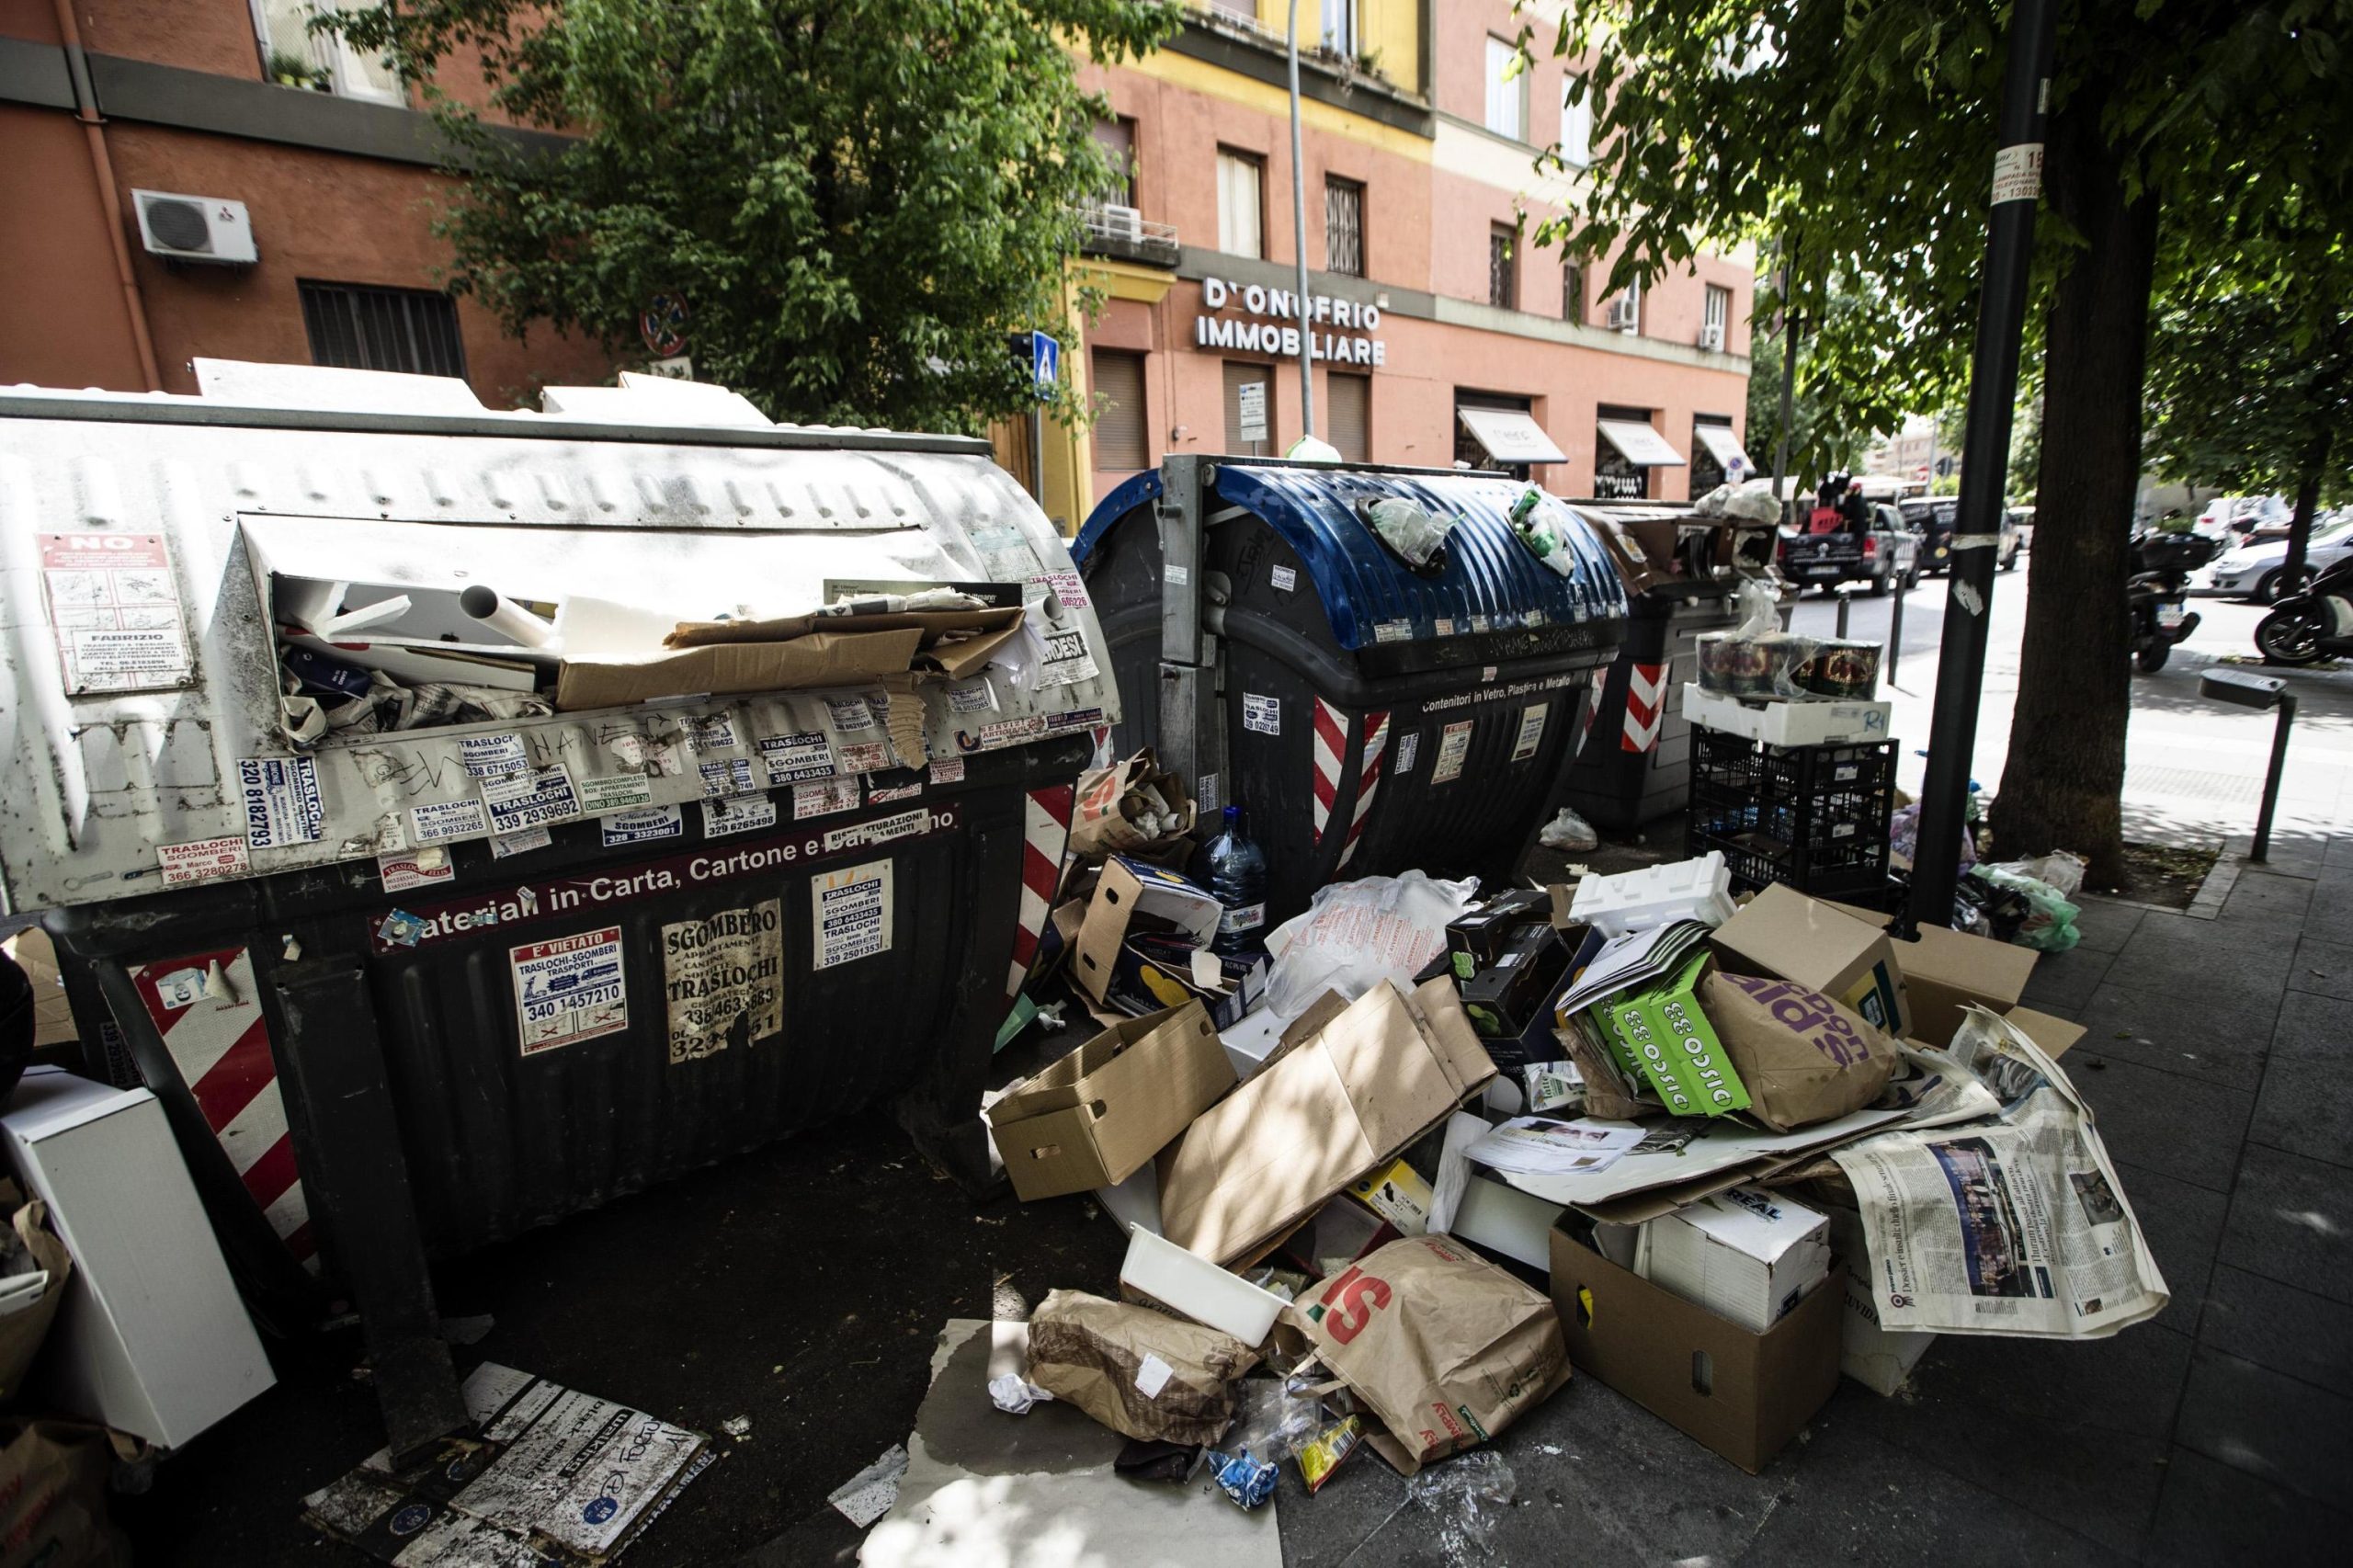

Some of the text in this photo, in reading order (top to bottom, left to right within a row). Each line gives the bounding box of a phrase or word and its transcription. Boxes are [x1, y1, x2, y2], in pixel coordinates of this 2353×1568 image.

[1198, 315, 1386, 365] IMMOBLIARE
[71, 536, 134, 550] NO
[1474, 691, 1482, 703] in
[1483, 688, 1506, 701] Vetro,
[463, 748, 508, 757] SGOMBERI
[763, 736, 823, 750] TRASLOCHI
[467, 760, 529, 777] 338 6715053
[767, 753, 829, 768] SGOMBERI
[270, 761, 281, 785] SIMONE
[483, 774, 527, 788] SGOMBRO
[614, 775, 645, 785] COMPLETO
[775, 767, 832, 782] 380 6433435
[600, 781, 645, 792] APPARTAMENTI
[600, 790, 633, 799] TRASLOCHI
[241, 761, 271, 846] 320 8182793
[290, 759, 310, 840] SGOMBRO CANTINE
[299, 759, 322, 838] TRASLOCHI
[415, 799, 480, 815] TRASLOCHI
[496, 789, 569, 812] TRASLOCHI
[586, 801, 606, 811] DINO
[420, 813, 481, 828] SGOMBERI
[496, 801, 579, 831] 339 2939692
[614, 816, 669, 830] SGOMBERI
[709, 816, 774, 835] 329 6265498
[420, 828, 440, 839] 366
[441, 821, 484, 835] 9932265
[609, 826, 676, 844] 328 3323001
[162, 838, 244, 855] TRASLOCHI
[167, 846, 242, 861] SGOMBERI
[168, 863, 247, 882] 366 3280278
[187, 859, 212, 869] Marco
[386, 839, 819, 946] ateriali in Carta, Cartone e
[825, 881, 878, 900] TRASLOCHI
[825, 897, 880, 915] SGOMBERI
[827, 908, 879, 927] 380 6433435
[667, 910, 776, 955] SGOMBERO
[824, 917, 880, 938] TRASLOCHI
[533, 933, 604, 958] E' VIETATO
[825, 934, 879, 954] SGOMBERI
[519, 944, 617, 975] TRASLOCHI-SGOMBERI
[684, 955, 724, 970] CANTINE
[824, 943, 880, 966] 339 2501353
[547, 960, 594, 976] TRASPORTI
[668, 957, 779, 1002] TRASLOCHI
[529, 1003, 555, 1021] 340
[560, 985, 620, 1013] 1457210
[1643, 1043, 1689, 1109] DISCO
[1683, 1037, 1733, 1107] DISCO
[1881, 1181, 1897, 1202] finale
[1889, 1202, 1901, 1227] duello
[2026, 1193, 2039, 1219] destra
[2022, 1207, 2036, 1229] passa
[1890, 1227, 1904, 1255] insulti:
[2027, 1229, 2041, 1263] Thuram
[1885, 1258, 1896, 1293] Primo piano
[1898, 1261, 1913, 1293] Dossier
